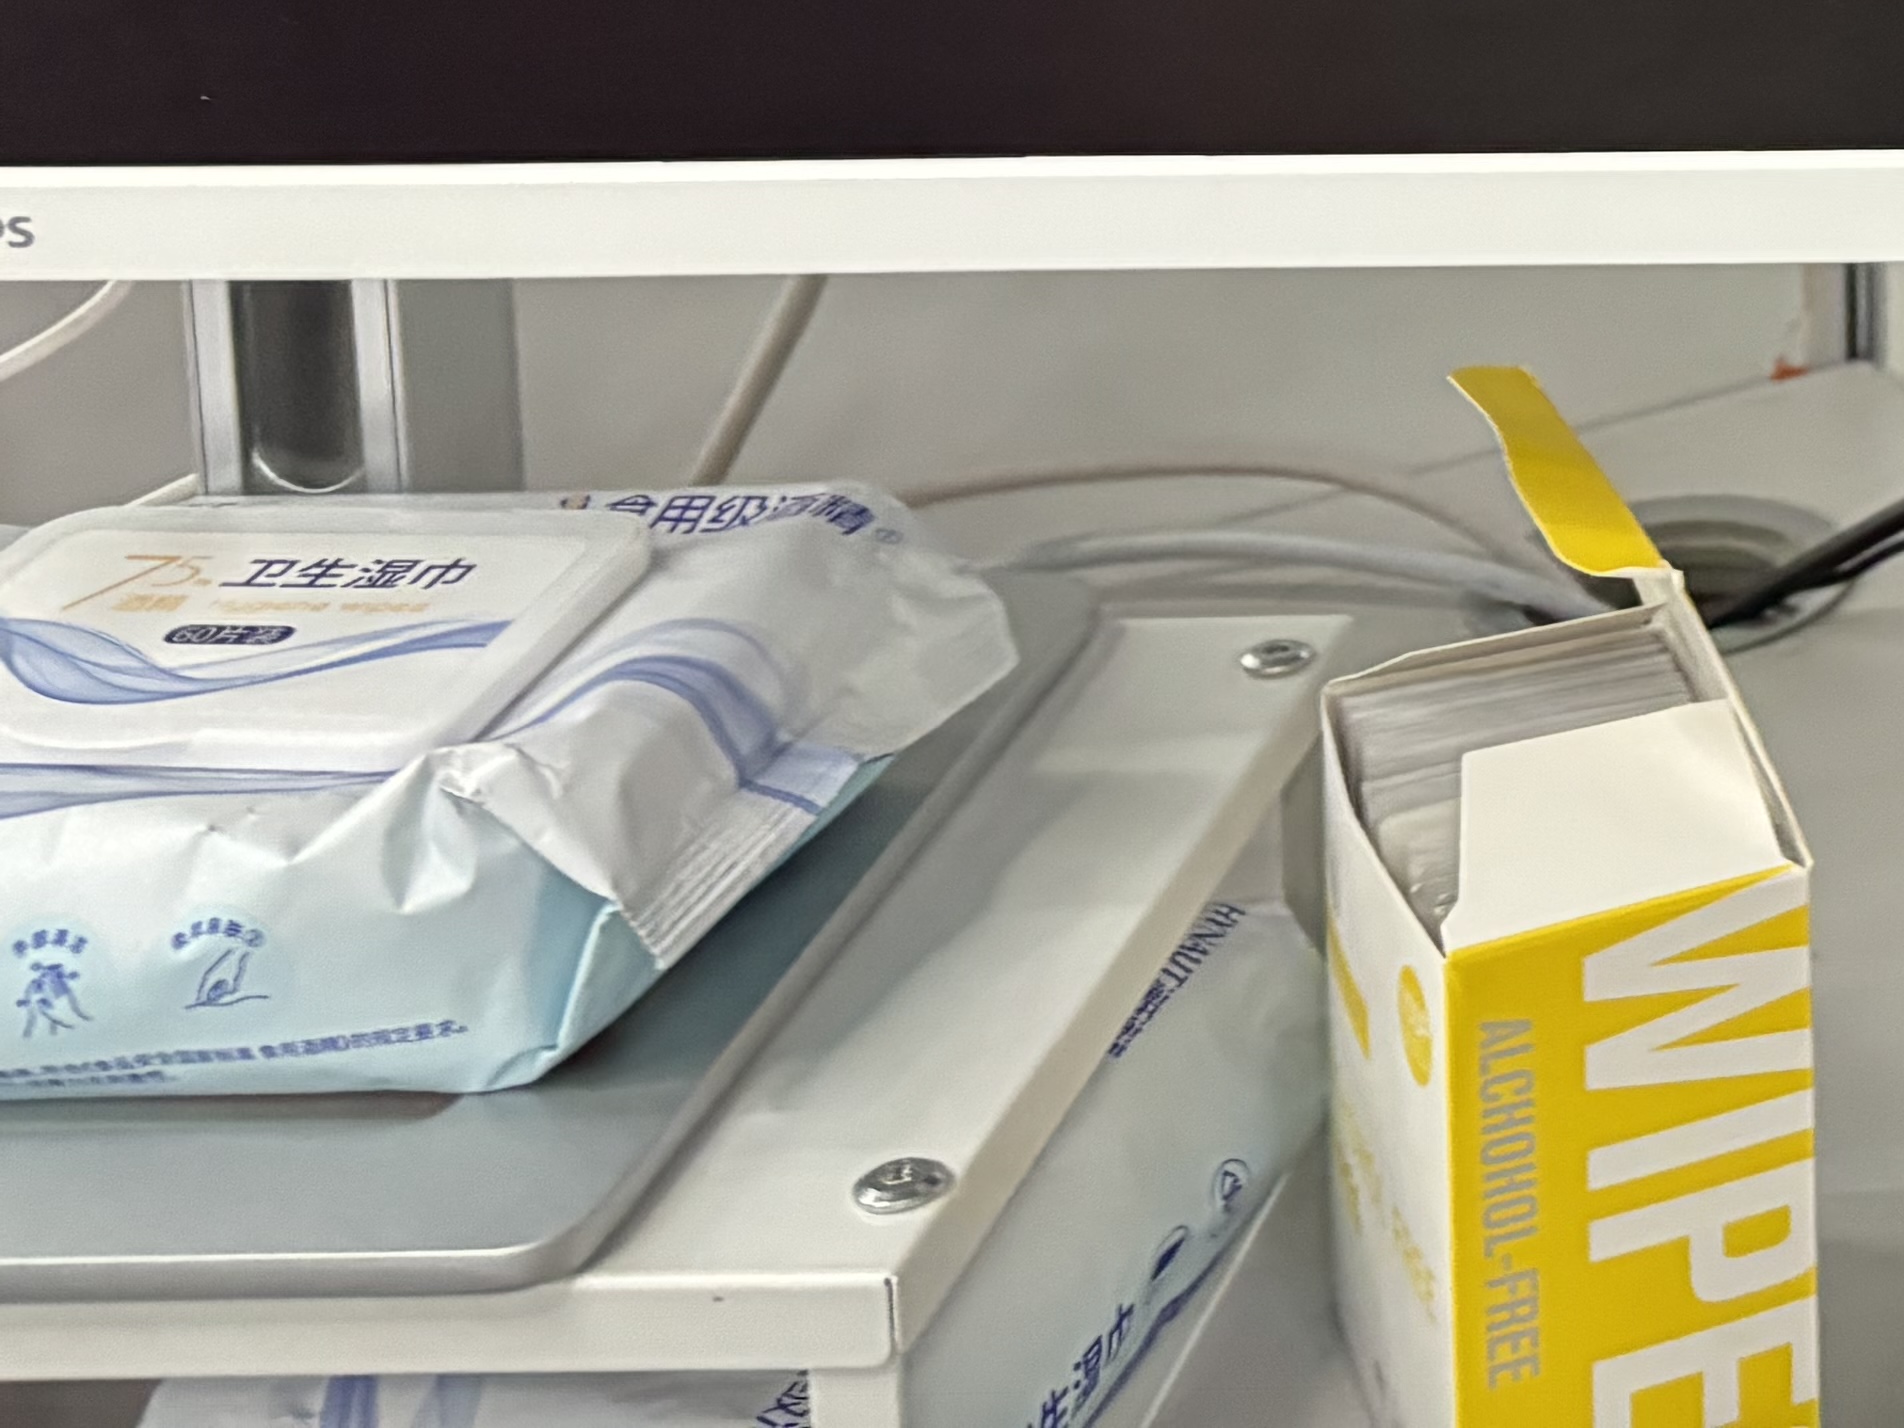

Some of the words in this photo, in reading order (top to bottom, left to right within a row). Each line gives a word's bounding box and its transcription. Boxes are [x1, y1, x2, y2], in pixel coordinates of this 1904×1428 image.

[218, 557, 478, 590] 卫生湿巾
[1477, 1017, 1542, 1391] ALCHOHOL-FREE
